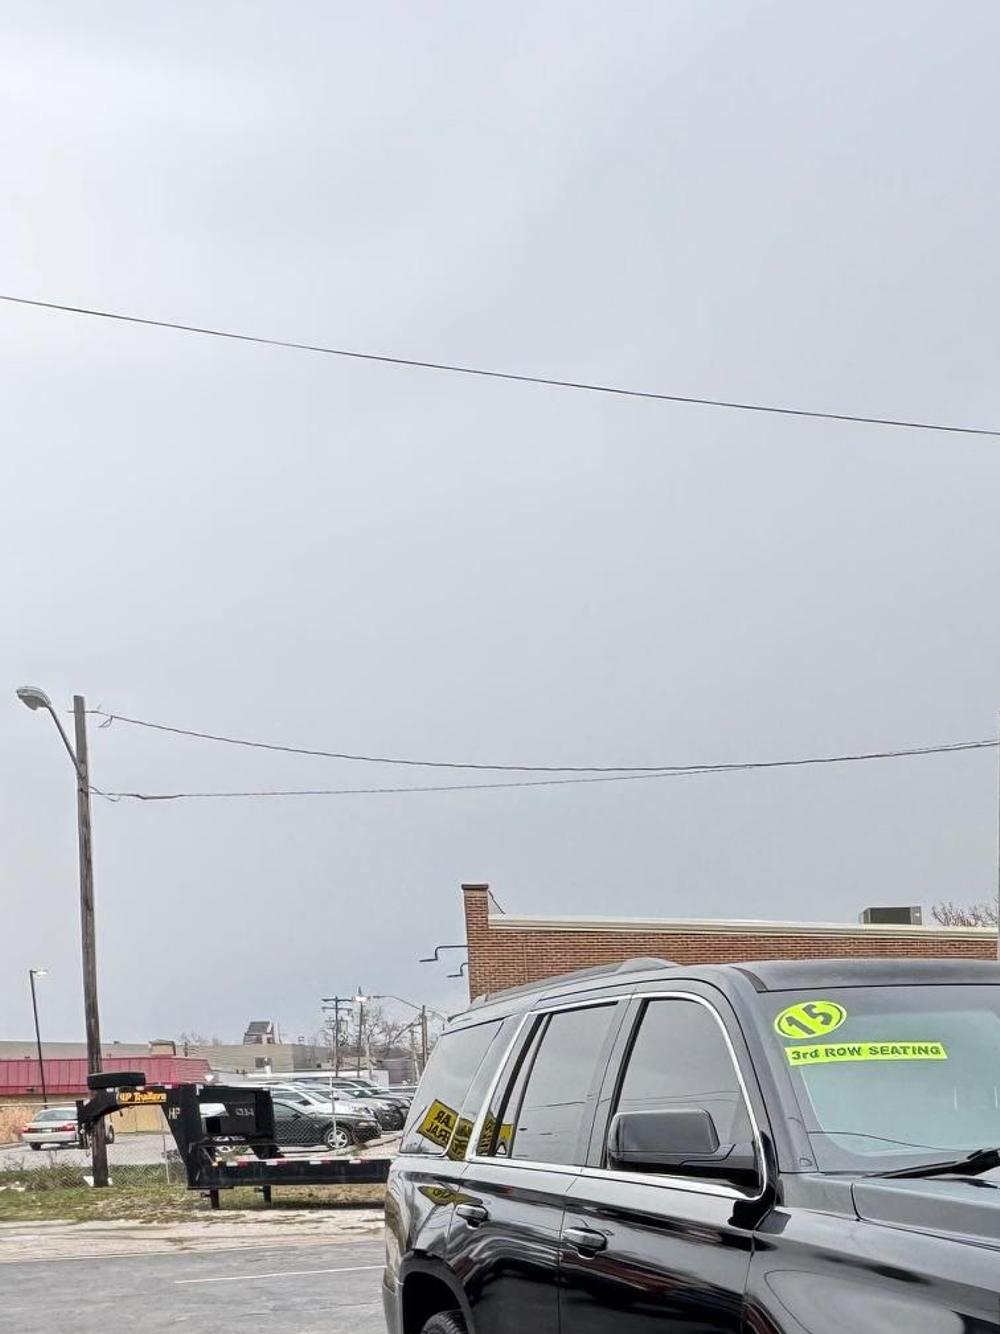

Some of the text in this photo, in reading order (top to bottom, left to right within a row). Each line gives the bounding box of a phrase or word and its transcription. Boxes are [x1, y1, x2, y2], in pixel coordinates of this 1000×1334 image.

[785, 1003, 833, 1036] 15
[791, 1045, 941, 1061] 3rd ROW SEATING
